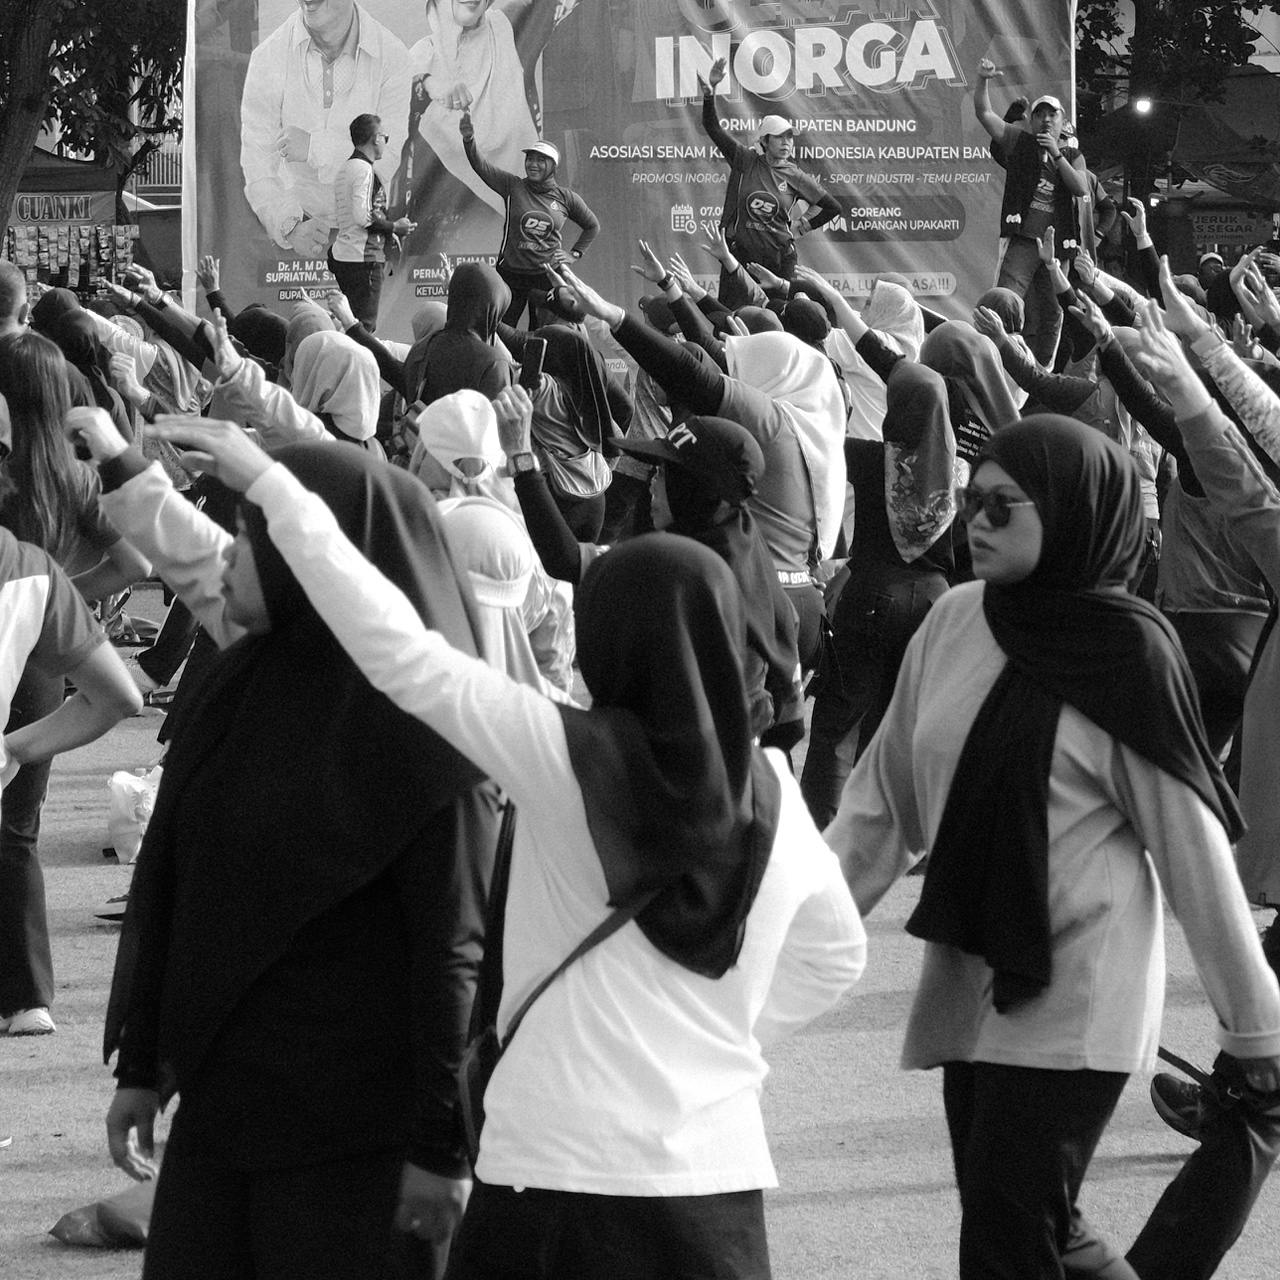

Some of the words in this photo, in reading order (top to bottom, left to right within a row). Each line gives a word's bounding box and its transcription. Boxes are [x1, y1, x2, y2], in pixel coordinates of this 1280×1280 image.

[655, 20, 957, 99] INORGA
[719, 118, 756, 132] ORMI
[846, 119, 917, 132] BANDUNG
[590, 145, 654, 159] ASOSIASI
[656, 145, 706, 159] SENAM
[799, 146, 875, 159] INDONESIA
[878, 146, 960, 159] KABUPATEN
[632, 173, 683, 184] PROMOSI
[685, 173, 727, 184] INORGA
[829, 173, 866, 184] SPORT
[866, 173, 914, 184] INDUSTRI
[923, 173, 952, 183] TEMU
[954, 173, 991, 184] PEGIAT
[18, 193, 92, 221] CUANKI
[700, 205, 724, 216] 07.0
[850, 207, 901, 218] SOREANG
[850, 220, 908, 231] LAPANGAN
[909, 219, 960, 231] UPAKARTI
[278, 261, 291, 271] Dr.
[292, 261, 303, 271] H.
[305, 261, 314, 270] M
[265, 271, 321, 283] SUPRIATNA,
[279, 291, 308, 300] BUPA
[416, 286, 445, 296] KETUA
